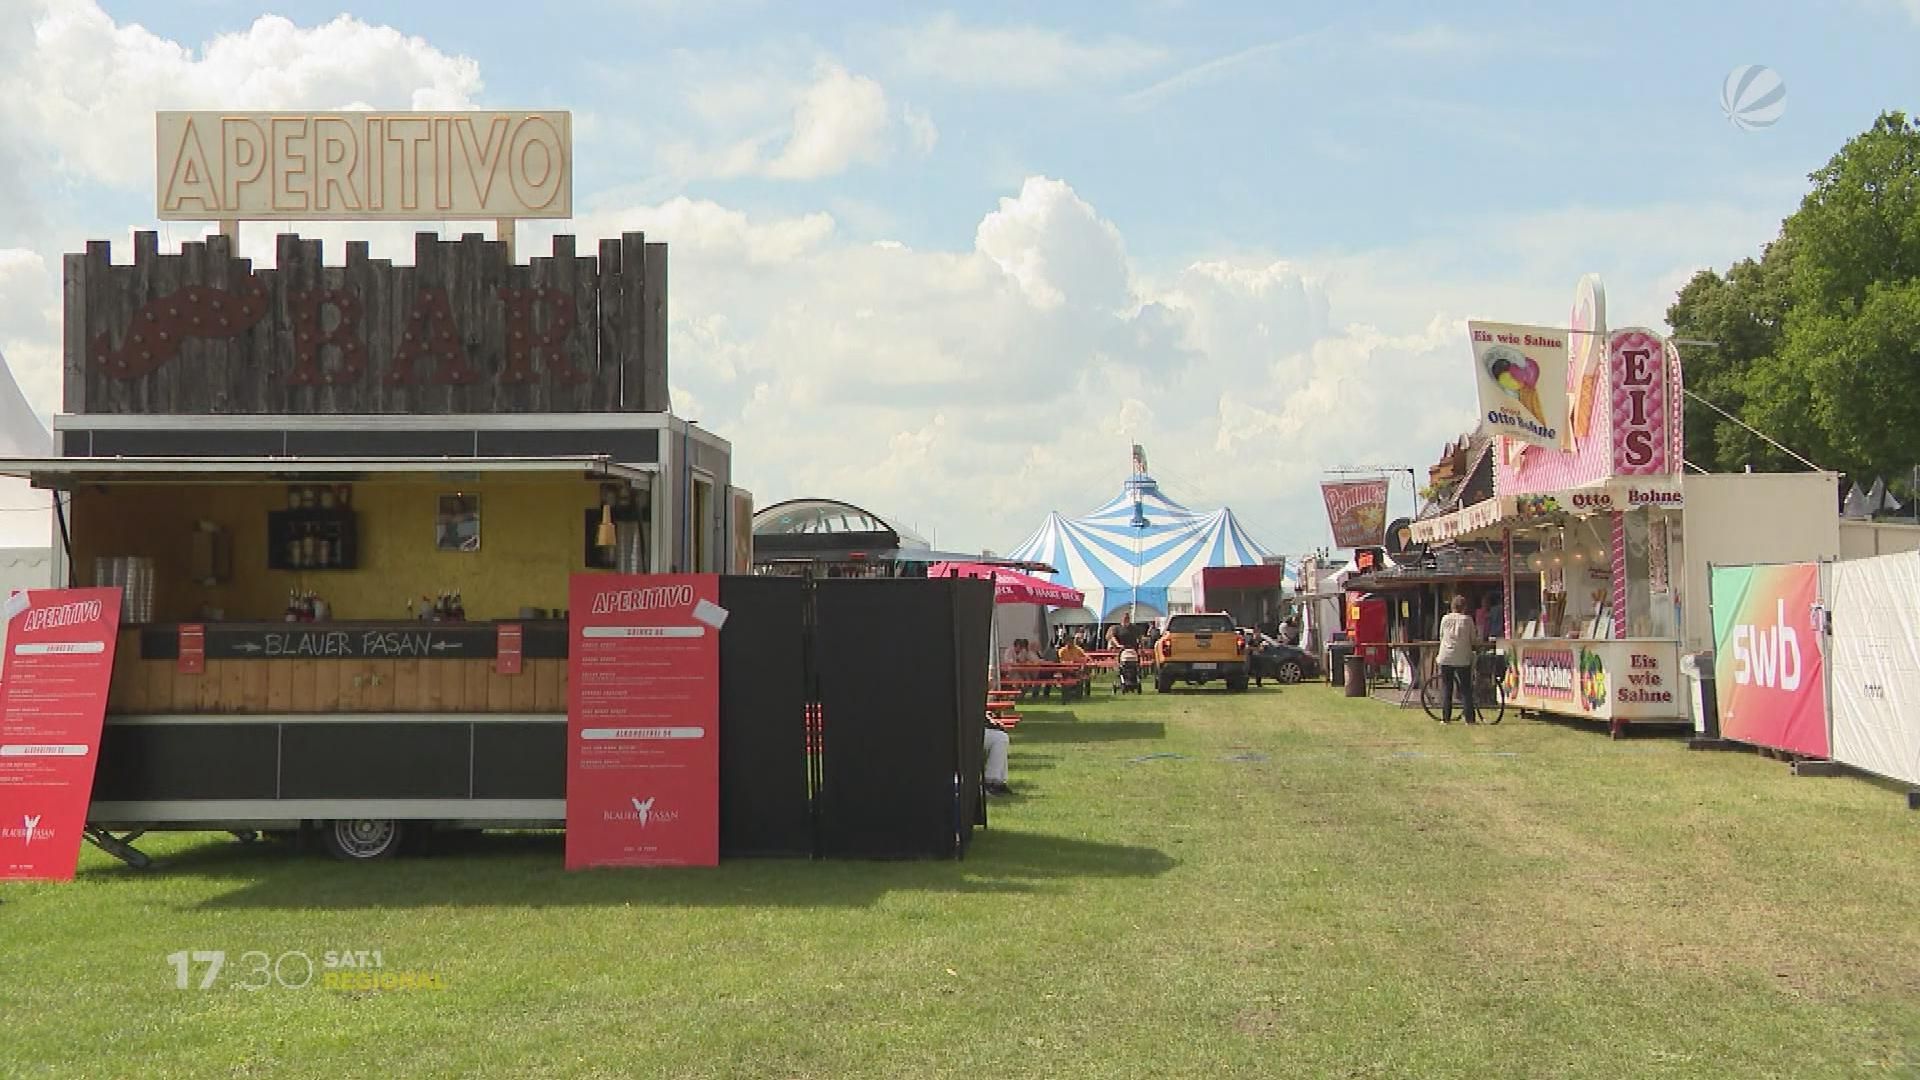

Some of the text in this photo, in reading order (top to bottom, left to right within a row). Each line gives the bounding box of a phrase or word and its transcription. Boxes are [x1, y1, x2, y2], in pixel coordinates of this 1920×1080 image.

[163, 115, 564, 211] APERITIVO
[291, 286, 587, 386] BAR
[1473, 330, 1562, 349] Eis wie Sahne
[1622, 348, 1653, 466] EIS
[1487, 410, 1516, 425] Otto
[1572, 489, 1682, 508] Otto Bohne
[591, 584, 694, 614] APERITIVO
[24, 599, 102, 632] APERITIVO
[264, 631, 433, 657] BLAUER FASAN
[1732, 598, 1801, 692] swb
[1630, 654, 1657, 669] Eis
[1628, 671, 1663, 686] wie
[1617, 687, 1673, 703] Sahne
[603, 810, 679, 822] BLAUER FASAN
[2, 828, 55, 839] BLAUER FASAN
